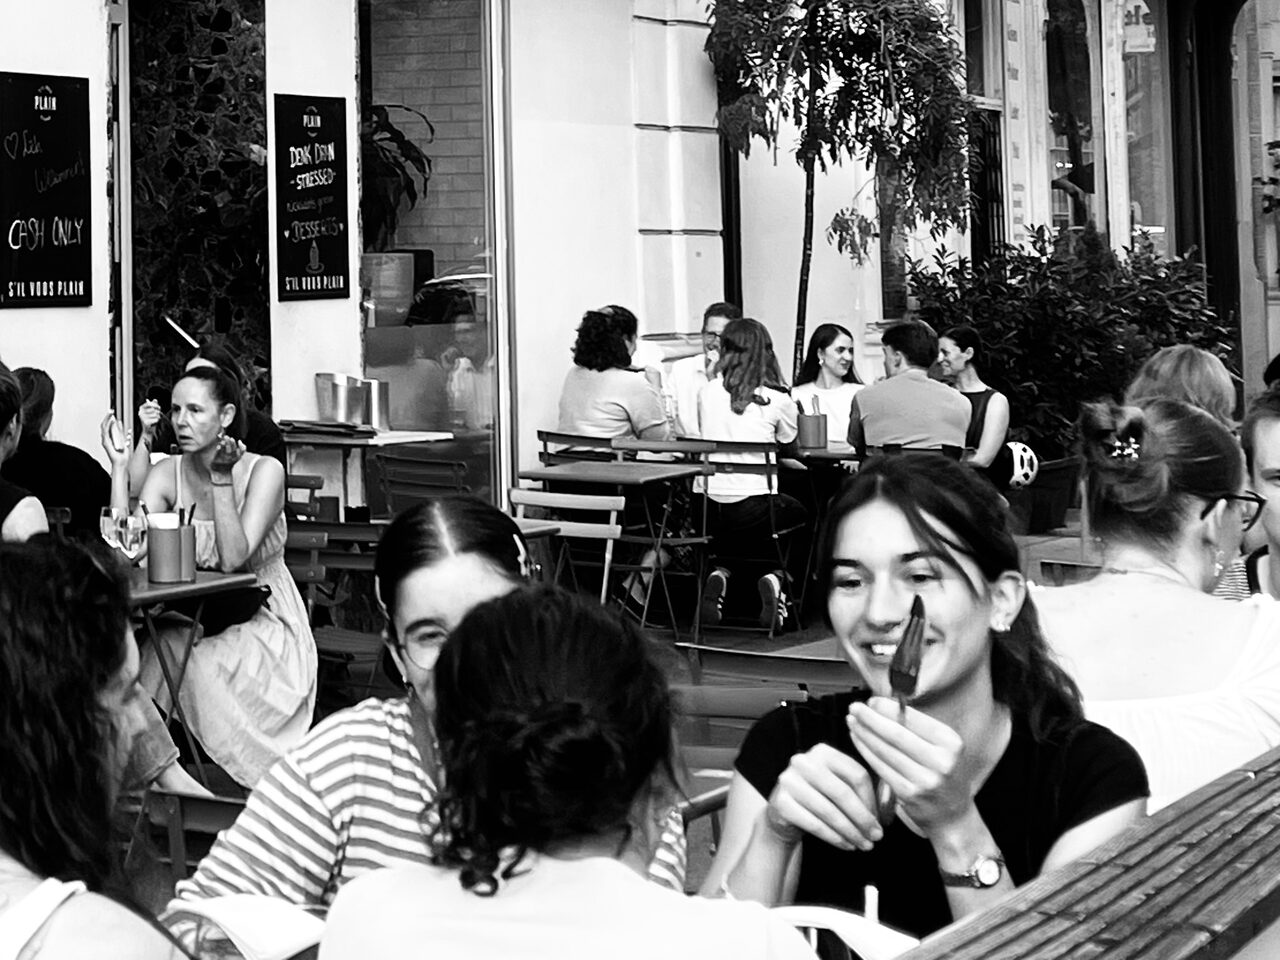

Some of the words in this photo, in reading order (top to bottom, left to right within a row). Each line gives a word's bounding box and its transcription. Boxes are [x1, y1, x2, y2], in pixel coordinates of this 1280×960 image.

[34, 95, 57, 111] PLAIN
[303, 114, 321, 128] PLAIN
[7, 217, 45, 252] CASH
[51, 216, 84, 247] ONLY
[8, 281, 26, 298] S'IL
[30, 281, 54, 297] VOUS
[58, 280, 84, 296] PLAIN
[323, 275, 344, 290] PLAIN
